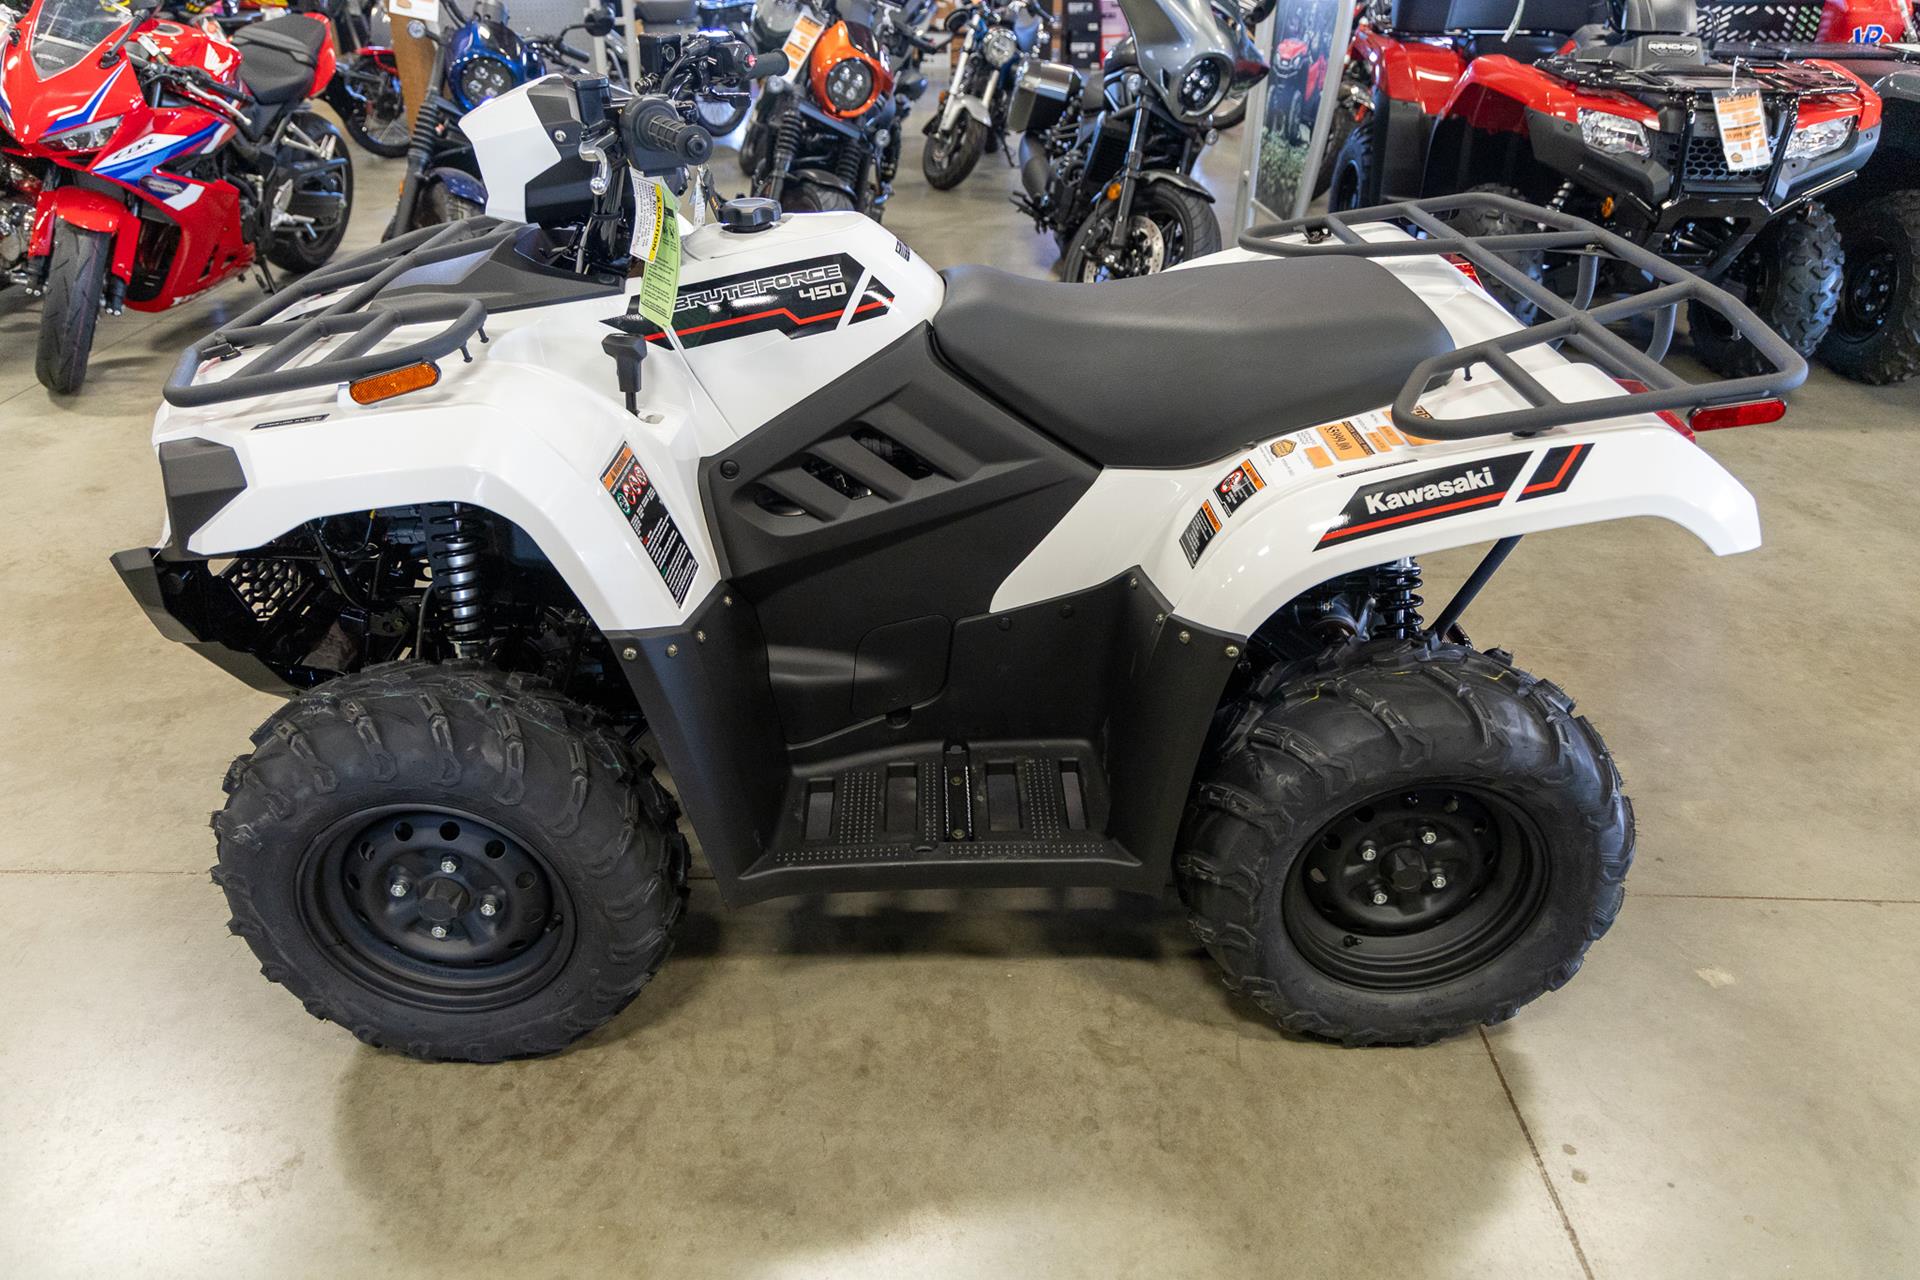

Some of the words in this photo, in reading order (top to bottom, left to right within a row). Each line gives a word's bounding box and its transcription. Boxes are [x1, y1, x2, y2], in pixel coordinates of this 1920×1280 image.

[651, 206, 663, 252] CAUTION
[798, 281, 847, 301] 450
[1364, 466, 1495, 515] Kawasaki
